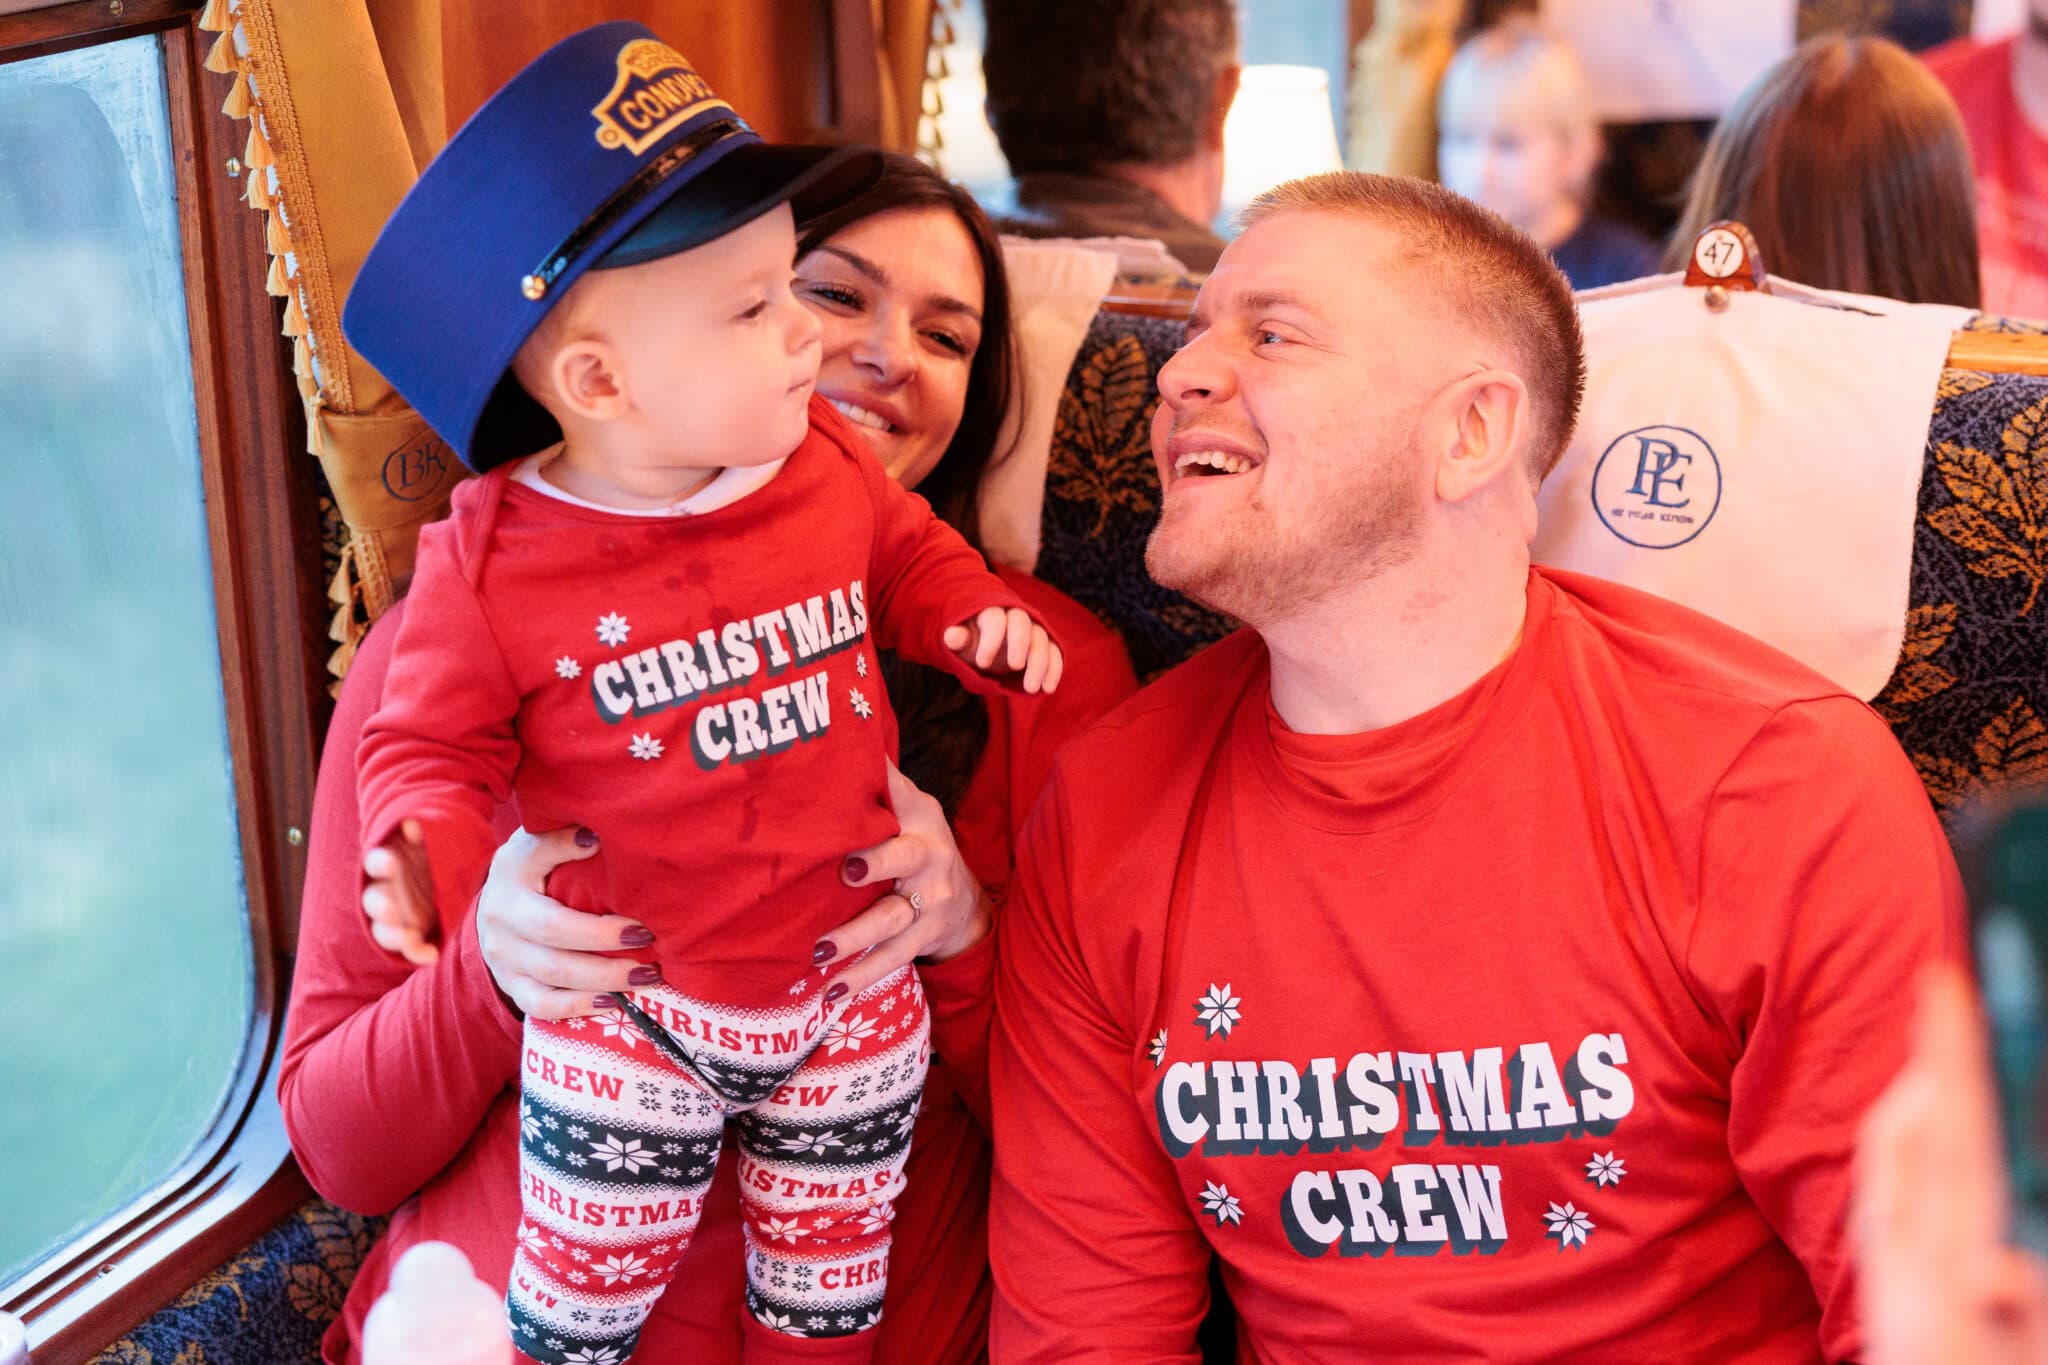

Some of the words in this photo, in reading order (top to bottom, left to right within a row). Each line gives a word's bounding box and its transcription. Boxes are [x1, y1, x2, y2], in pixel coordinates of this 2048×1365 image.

[1703, 241, 1735, 265] 47
[592, 580, 867, 718] CHRISTMAS
[693, 671, 831, 765] CREW
[526, 1049, 625, 1101] CREW
[1160, 1033, 1635, 1151] CHRISTMAS
[1286, 1163, 1508, 1250] CREW
